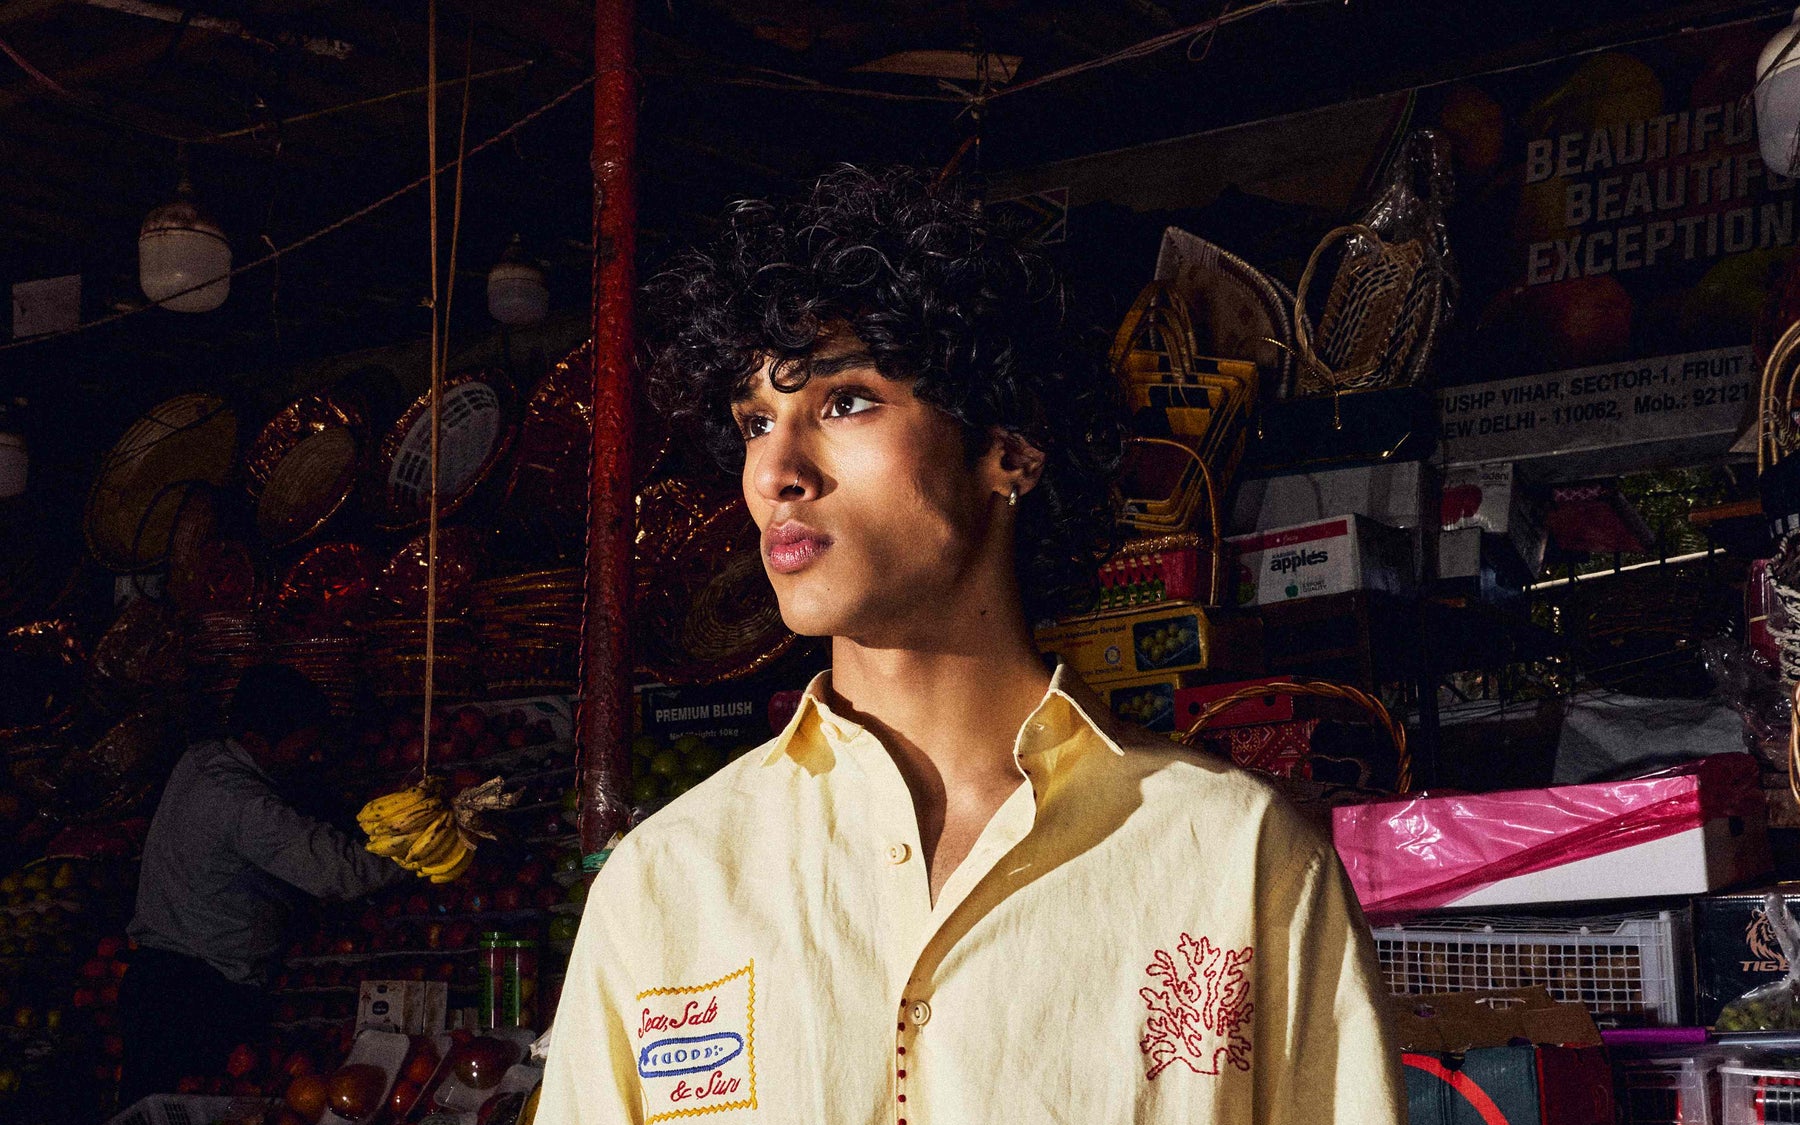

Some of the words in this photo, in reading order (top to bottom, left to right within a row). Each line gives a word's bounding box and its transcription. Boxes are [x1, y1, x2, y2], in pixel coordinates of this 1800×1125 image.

[1527, 200, 1794, 286] EXCEPTION
[1682, 355, 1744, 381] FRUIT
[1479, 415, 1535, 435] DELHI
[1270, 549, 1328, 574] apples
[655, 704, 710, 723] PREMIUM
[713, 701, 753, 718] BLUSH
[1739, 960, 1790, 972] TIGE
[669, 996, 718, 1029] Salt
[670, 1080, 692, 1101] &
[695, 1070, 741, 1099] Sun
